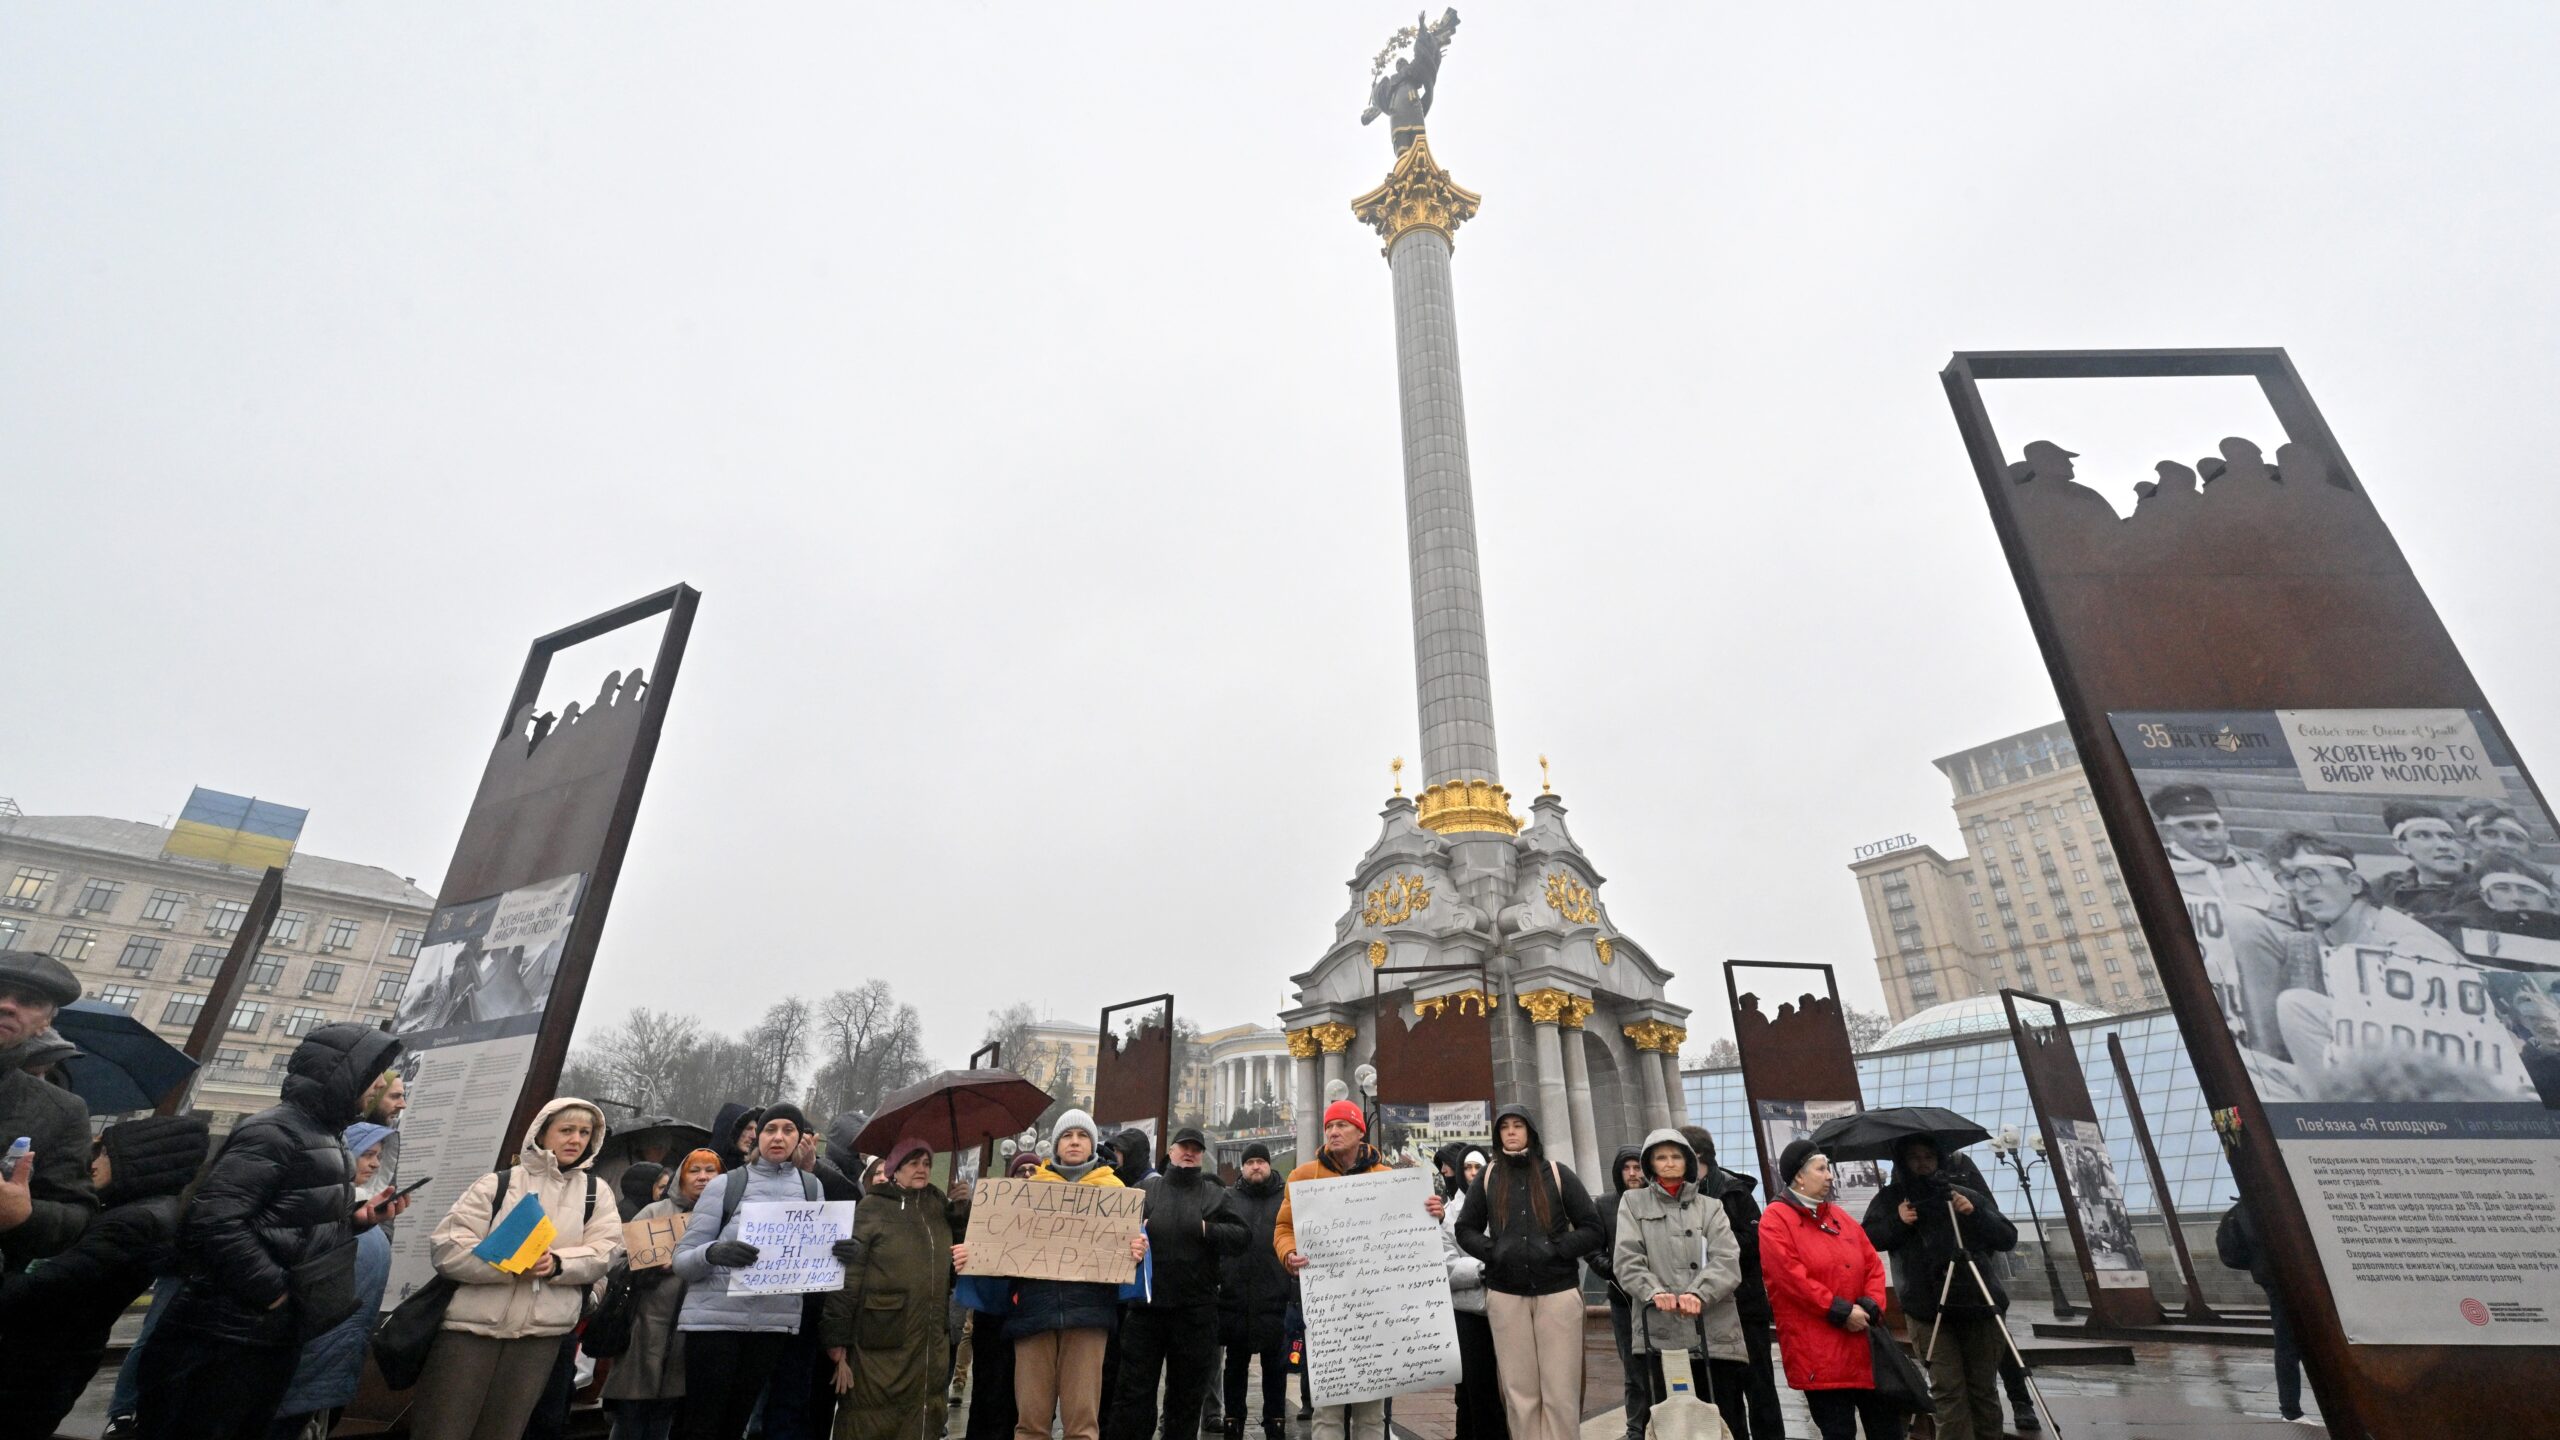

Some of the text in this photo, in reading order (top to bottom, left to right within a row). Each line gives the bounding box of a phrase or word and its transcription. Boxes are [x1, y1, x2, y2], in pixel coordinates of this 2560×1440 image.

[2137, 723, 2172, 749] 35
[2170, 733, 2270, 748] НА ГРНІТІ
[2308, 744, 2475, 764] ЖОВТЕНЬ 90-ГО
[2319, 764, 2482, 785] ВИБІР МОЛОДИХ
[1852, 832, 1918, 860] ГОТЕЛЬ
[2296, 1117, 2357, 1133] Пов'язка
[2381, 1118, 2448, 1136] голодую»
[973, 1180, 1144, 1218] ЗРАДНИКАМ
[785, 1203, 825, 1223] ТАК!
[745, 1221, 838, 1234] ВИБОРАМ ТА
[744, 1233, 794, 1246] ЗМІНІ
[780, 1245, 803, 1257] НІ
[748, 1256, 832, 1271] СИФІКАЦІЇ
[743, 1272, 800, 1286] ЗАКОНУ
